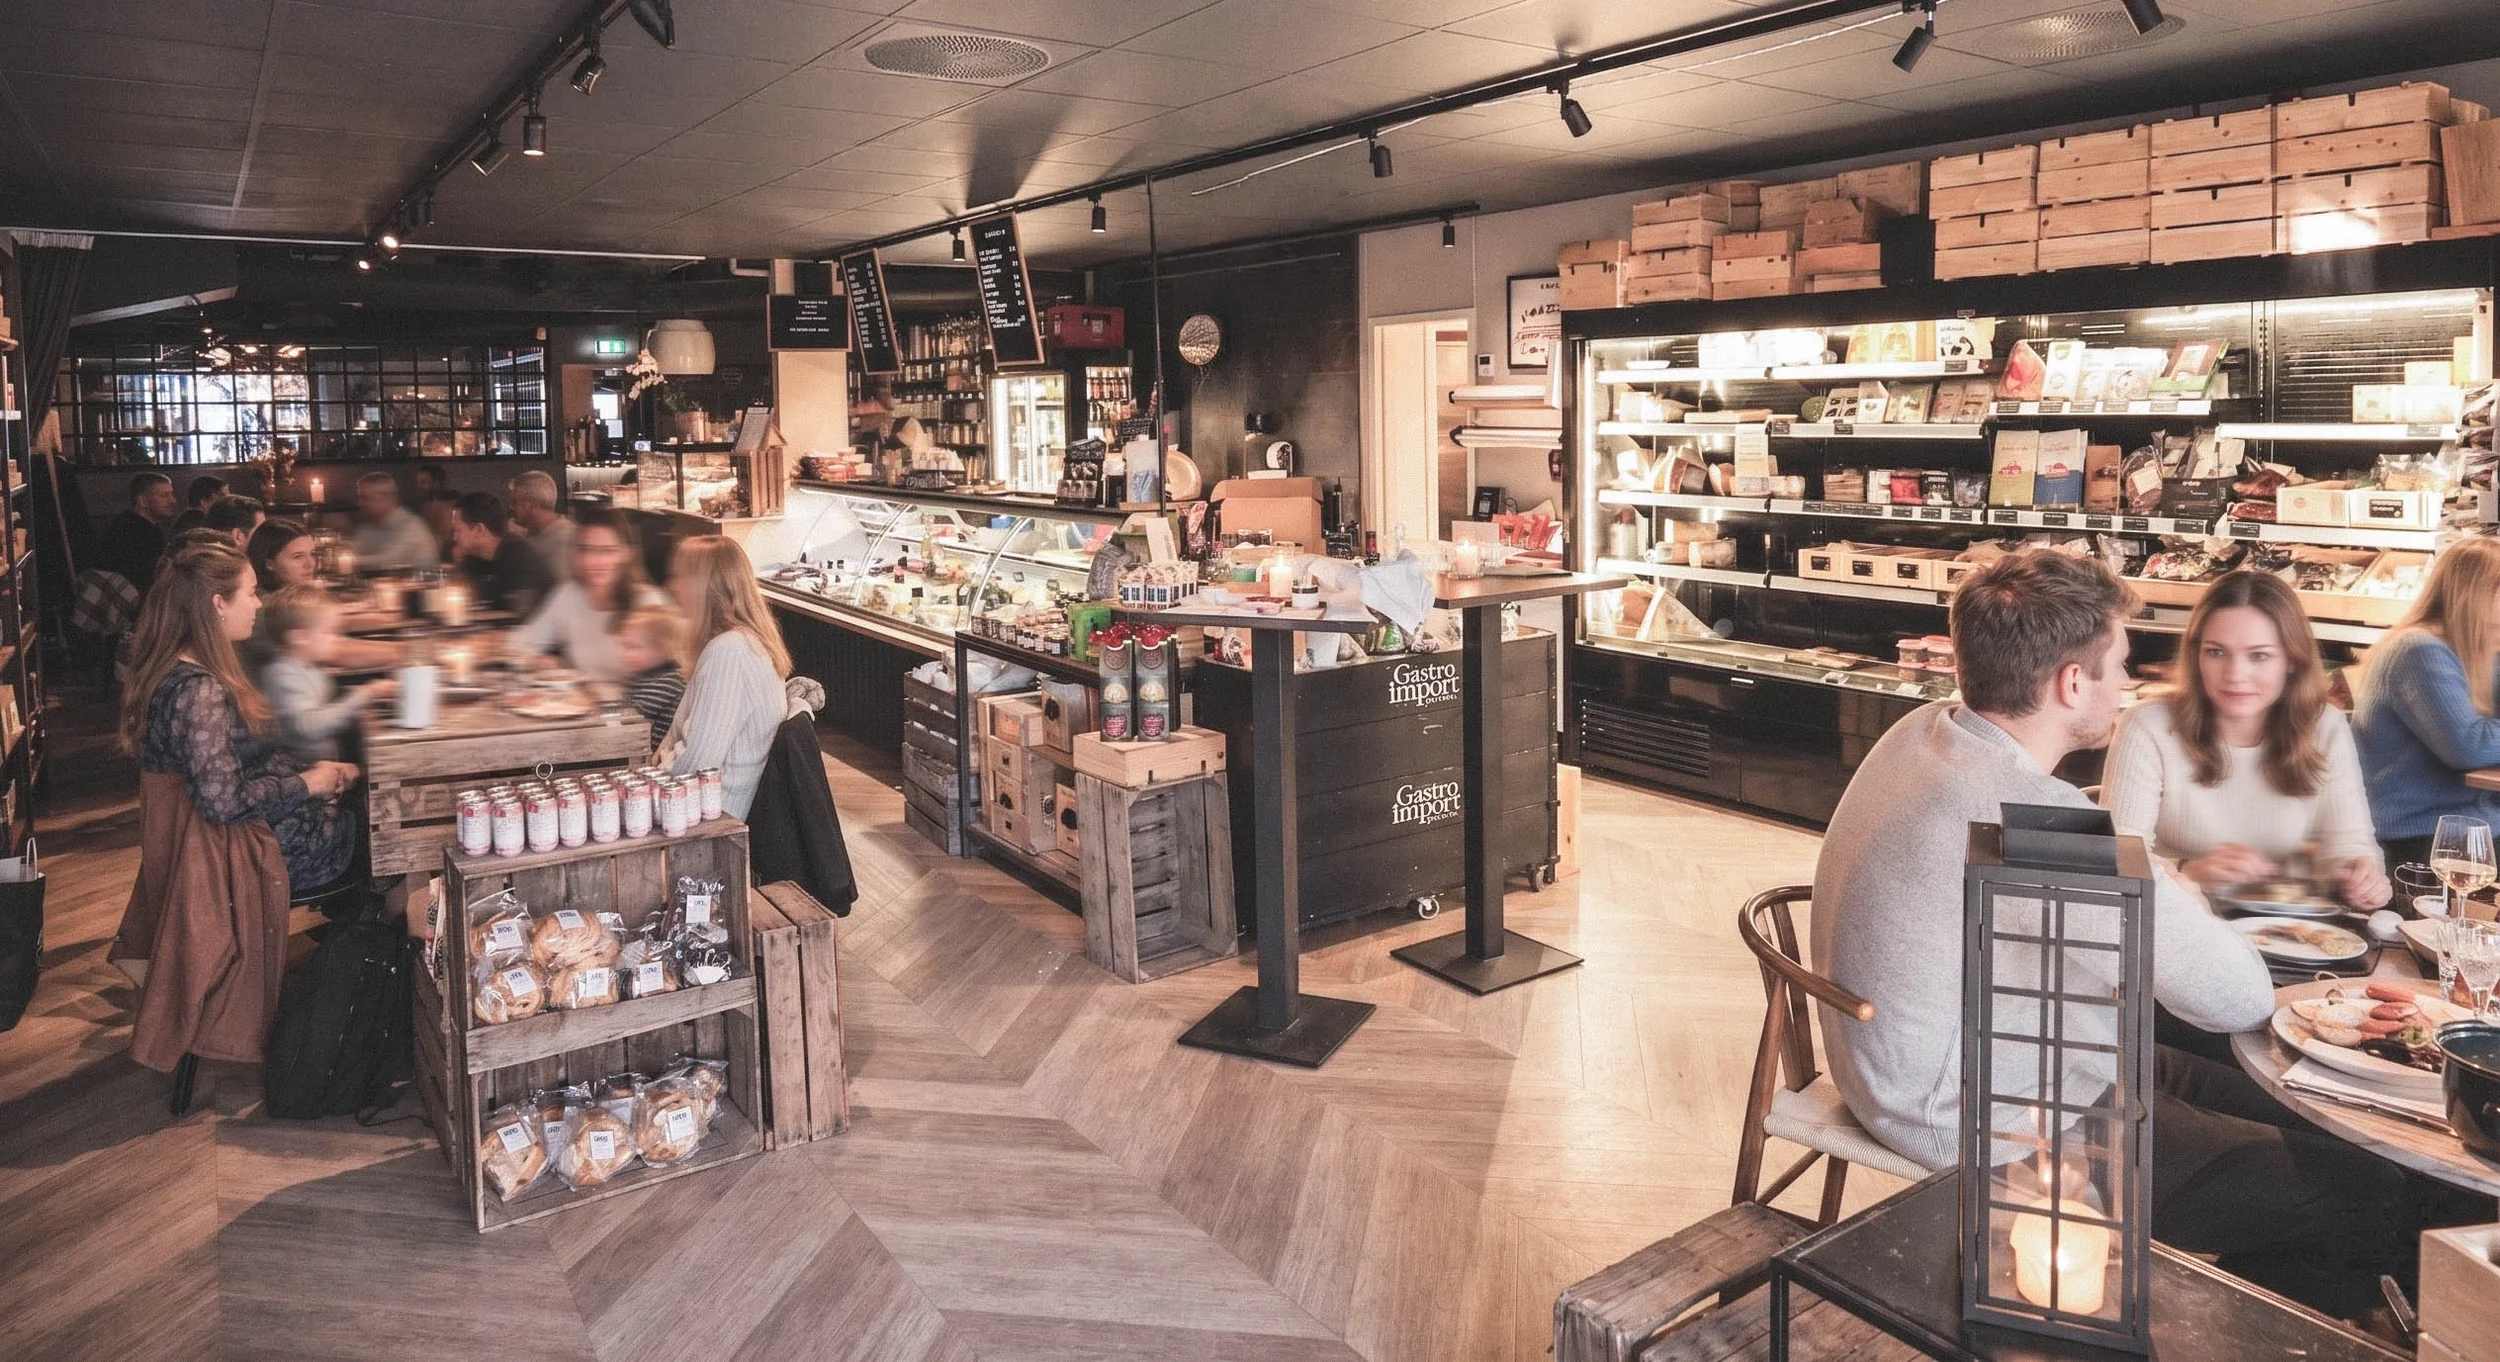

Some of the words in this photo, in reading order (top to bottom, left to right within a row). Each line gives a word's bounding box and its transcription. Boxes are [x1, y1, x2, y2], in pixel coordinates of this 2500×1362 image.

[1393, 663, 1456, 685] Gastro
[1388, 676, 1460, 706] import
[1396, 782, 1459, 806] Gastro
[1392, 793, 1461, 825] import
